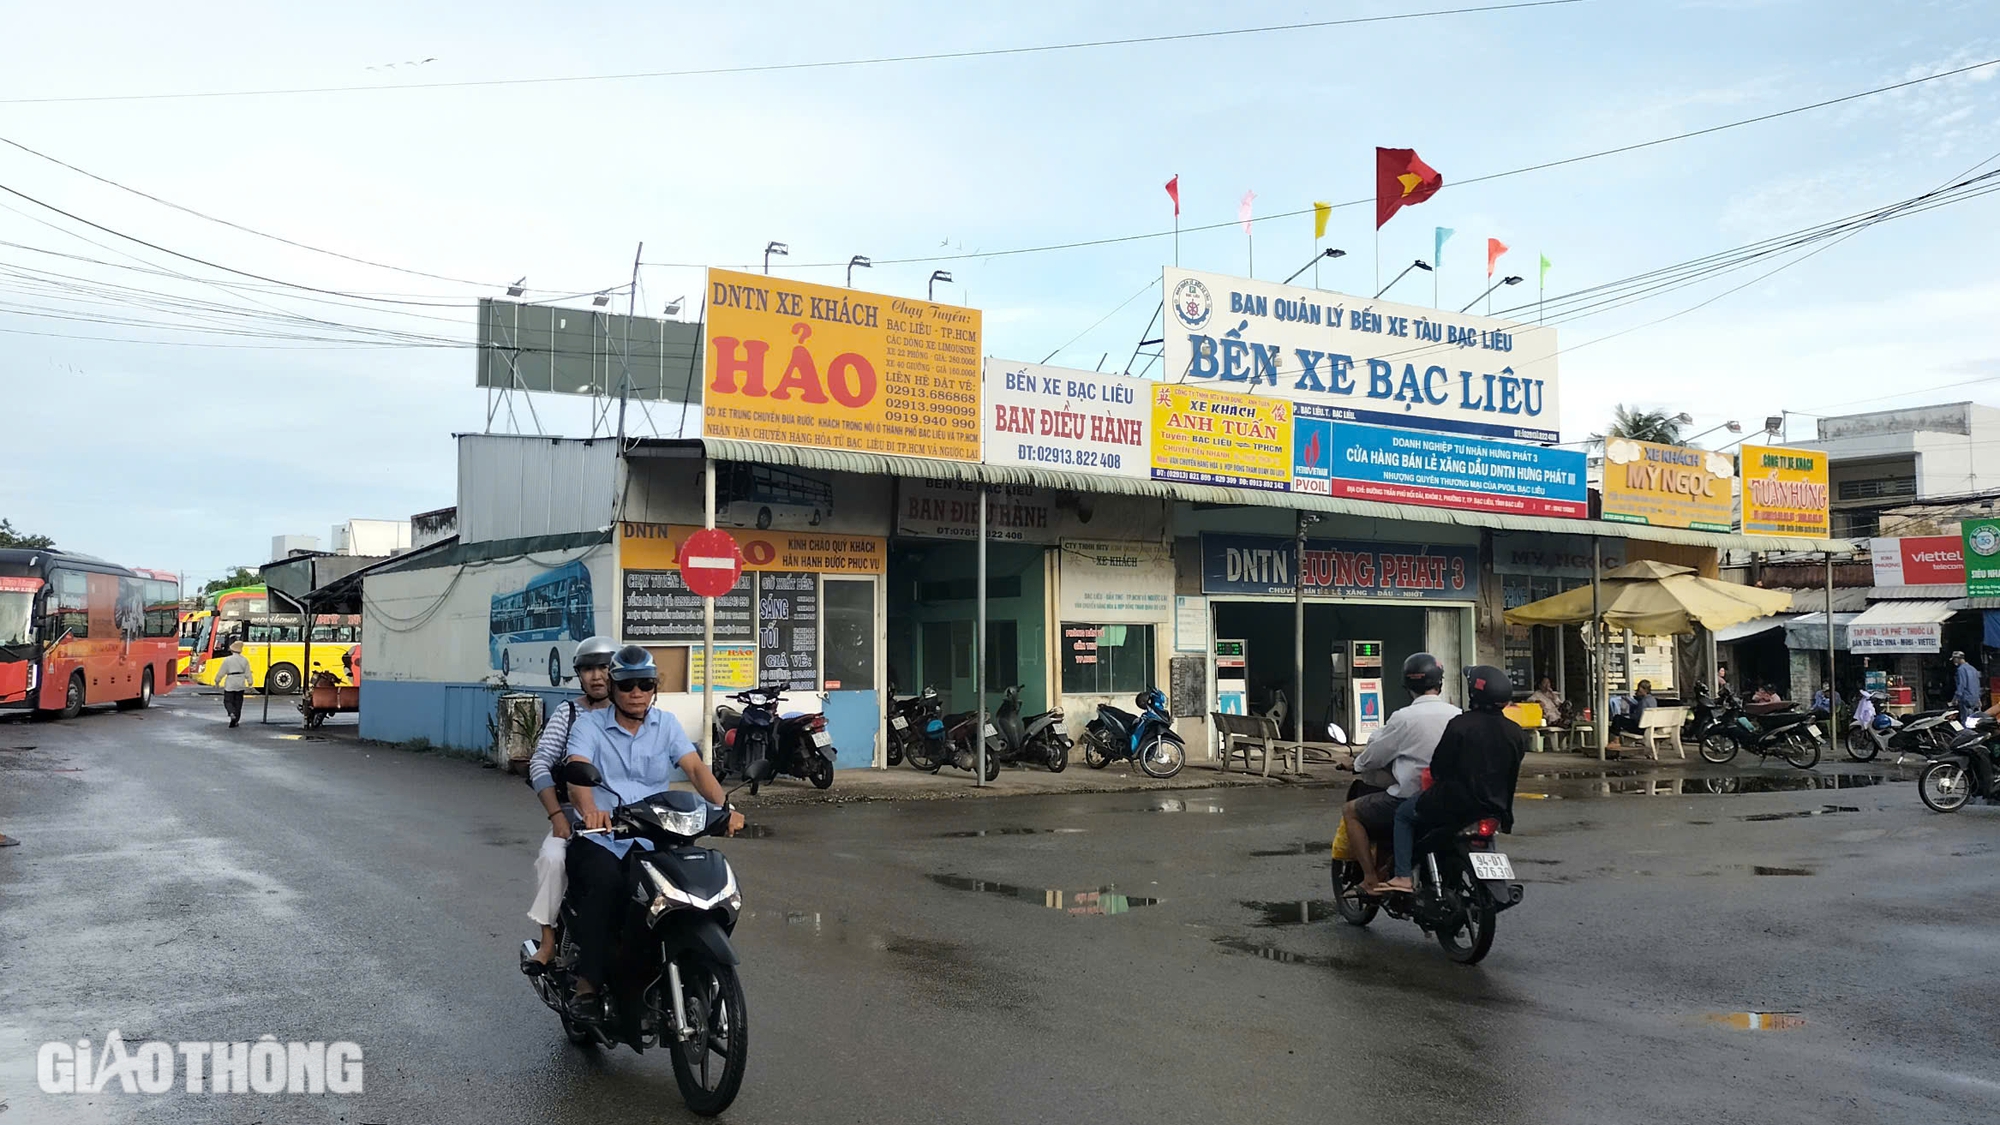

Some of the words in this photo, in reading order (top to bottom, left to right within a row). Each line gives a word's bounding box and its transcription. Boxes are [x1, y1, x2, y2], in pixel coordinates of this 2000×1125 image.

[712, 281, 770, 312] DNTN
[776, 291, 804, 316] XE
[810, 296, 879, 328] KHÁCH
[891, 300, 923, 319] Chạy
[886, 318, 906, 333] BẠC
[909, 321, 932, 336] LIÊU
[941, 326, 976, 342] TP.HCM
[1230, 292, 1267, 317] BAN
[1273, 297, 1321, 325] QUẢN
[1326, 303, 1344, 328] LÝ
[1350, 306, 1382, 334] BẾN
[1387, 315, 1408, 337] XE
[1447, 324, 1477, 349] BẠC
[1482, 328, 1513, 352] LIÊU
[925, 340, 936, 350] XE
[710, 322, 877, 408] HẢO
[1188, 320, 1281, 387] BẾN
[1294, 348, 1356, 396] XE
[1367, 358, 1449, 412] BẠC
[1459, 366, 1544, 417] LIÊU
[885, 371, 911, 384] LIÊN
[1006, 367, 1037, 393] BẾN
[1042, 377, 1062, 396] XE
[1067, 380, 1096, 403] BẠC
[1102, 383, 1134, 404] LIÊU
[885, 384, 976, 404] 02913.686868
[885, 397, 976, 417] 02913.999099
[1189, 400, 1207, 412] XE
[1211, 403, 1256, 418] KHÁCH
[885, 410, 947, 427] 0919.940
[951, 418, 976, 430] 990
[995, 404, 1036, 435] BAN
[1040, 400, 1086, 440] ĐIỀU
[1090, 409, 1143, 446] HÀNH
[1167, 413, 1214, 432] ANH
[1221, 418, 1277, 440] TUẤN
[897, 442, 925, 454] TP.HCM
[1192, 434, 1210, 445] BẠC
[1213, 436, 1232, 447] LIÊU
[1253, 442, 1283, 453] TPHCM
[1392, 437, 1421, 450] DOANH
[1422, 440, 1453, 454] NGHIỆP
[1466, 446, 1488, 457] NHÂN
[1512, 450, 1532, 463] PHÁT
[1533, 453, 1538, 463] 3
[1100, 452, 1121, 469] 408
[1346, 444, 1369, 465] CỬA
[1370, 448, 1400, 467] HÀNG
[1401, 450, 1423, 469] BÁN
[1424, 453, 1438, 471] LẺ
[1439, 456, 1469, 474] XĂNG
[1468, 457, 1488, 477] DẦU
[1490, 466, 1516, 480] DNTN
[1517, 468, 1543, 482] HƯNG
[1544, 468, 1567, 485] PHÁT
[1644, 447, 1660, 461] XE
[1661, 449, 1699, 467] KHÁCH
[1295, 479, 1328, 493] PVOIL
[1660, 468, 1715, 502] NGỌC
[909, 497, 945, 521] BAN
[999, 499, 1048, 528] HÀNH
[624, 523, 668, 540] DNTN
[788, 538, 807, 551] KÍNH
[808, 539, 831, 551] CHÀO
[832, 540, 848, 554] QUÝ
[850, 540, 876, 553] KHÁCH
[801, 556, 823, 569] HẠNH
[824, 556, 846, 569] ĐƯỢC
[847, 558, 869, 571] PHỤC
[870, 559, 880, 571] VỤ
[1110, 554, 1138, 567] KHÁCH
[1226, 547, 1287, 584] DNTN
[1294, 548, 1375, 588] HƯNG
[1380, 545, 1446, 590] PHÁT
[1452, 557, 1465, 590] 3
[1269, 587, 1297, 595] CHUYÊ
[1346, 588, 1368, 596] XĂNG
[760, 593, 789, 620] SÁNG
[760, 620, 779, 649] TỐI
[765, 652, 789, 667] GIÁ
[790, 652, 812, 667] VÉ:
